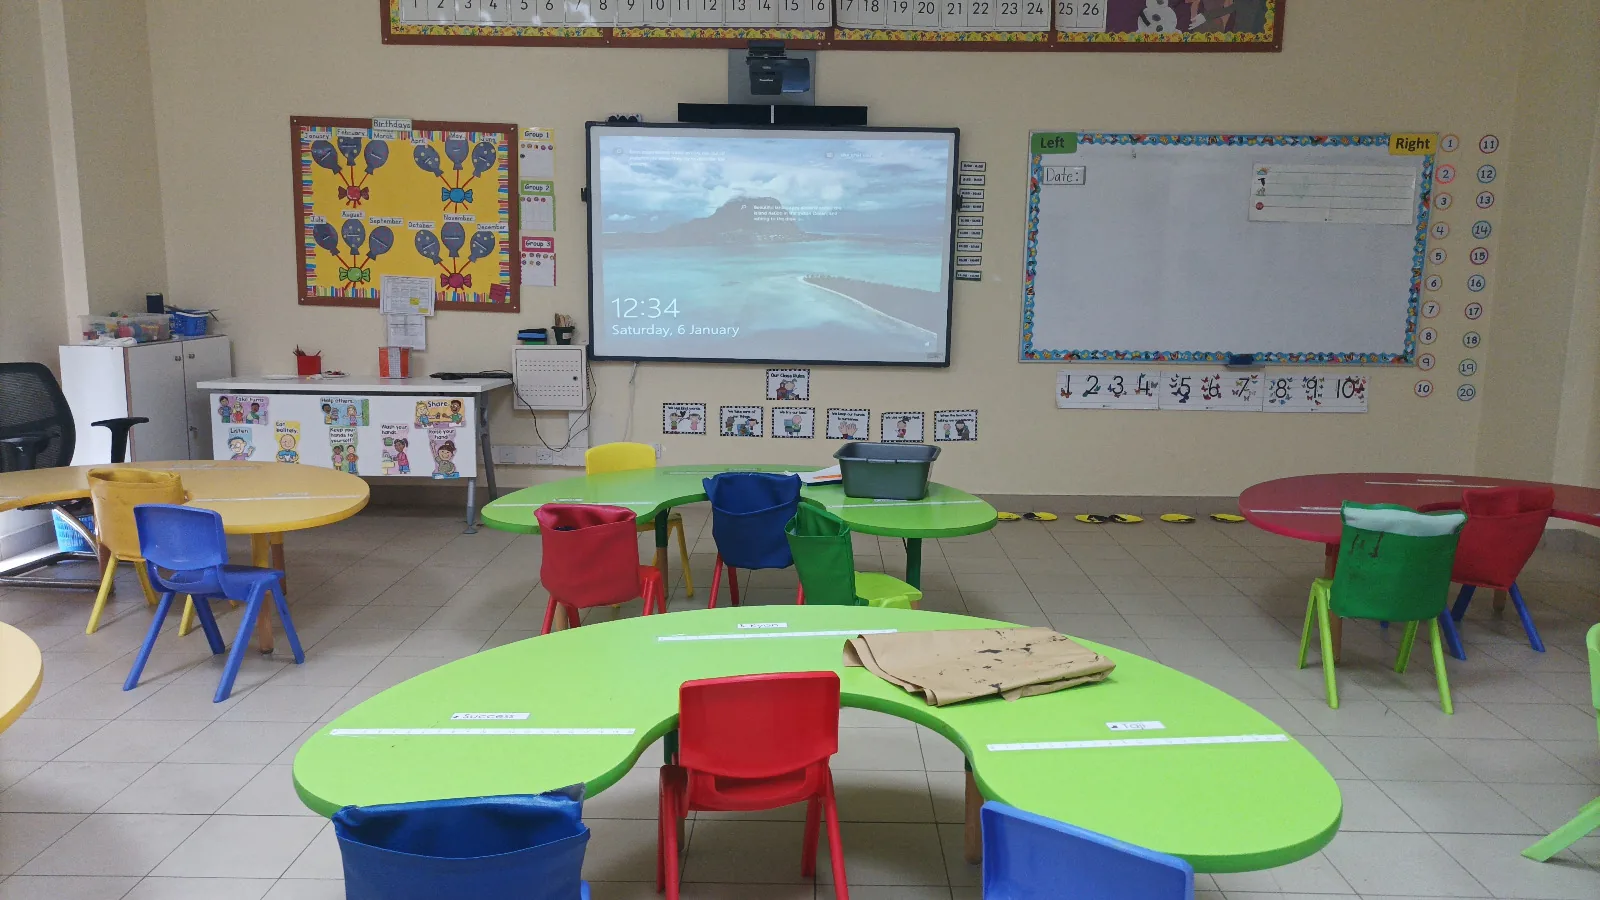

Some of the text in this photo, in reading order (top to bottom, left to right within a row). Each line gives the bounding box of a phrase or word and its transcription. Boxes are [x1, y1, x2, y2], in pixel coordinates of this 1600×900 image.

[627, 0, 635, 11] 9
[649, 0, 665, 11] 10
[677, 0, 691, 11] 11
[703, 0, 717, 11] 12
[731, 0, 746, 11] 13
[758, 0, 771, 11] 14
[784, 0, 799, 11] 15
[811, 0, 825, 11] 16
[839, 0, 1044, 15] 17 18 19 20 21 22 23 24
[1058, 2, 1099, 16] 25 26
[373, 119, 411, 129] Birthdays
[524, 131, 544, 139] Group
[1040, 136, 1065, 149] Left
[1395, 137, 1430, 151] Right
[1447, 140, 1453, 148] 1
[1483, 140, 1495, 149] 11
[1046, 167, 1079, 182] Date:
[1442, 169, 1449, 179] 2
[1480, 169, 1493, 179] 12
[524, 184, 543, 192] Group
[1440, 197, 1447, 206] 3
[1479, 196, 1491, 205] 13
[1436, 227, 1444, 236] 4
[1475, 225, 1488, 235] 14
[525, 240, 544, 248] Group
[1435, 252, 1442, 261] 5
[1474, 252, 1486, 260] 15
[1430, 279, 1437, 288] 6
[1470, 279, 1482, 287] 16
[611, 297, 680, 319] 12:34
[1428, 305, 1435, 314] 7
[1468, 307, 1480, 316] 17
[612, 324, 740, 338] Saturday, 6 January
[1425, 332, 1432, 341] 8
[1466, 336, 1478, 344] 18
[1422, 357, 1430, 367] 9
[1461, 363, 1474, 372] 19
[1066, 374, 1150, 396] 1 2 3 4
[1179, 377, 1250, 397] 5 6 7
[1275, 379, 1356, 399] 8 9 10
[1417, 384, 1430, 393] 10
[1460, 388, 1474, 397] 20
